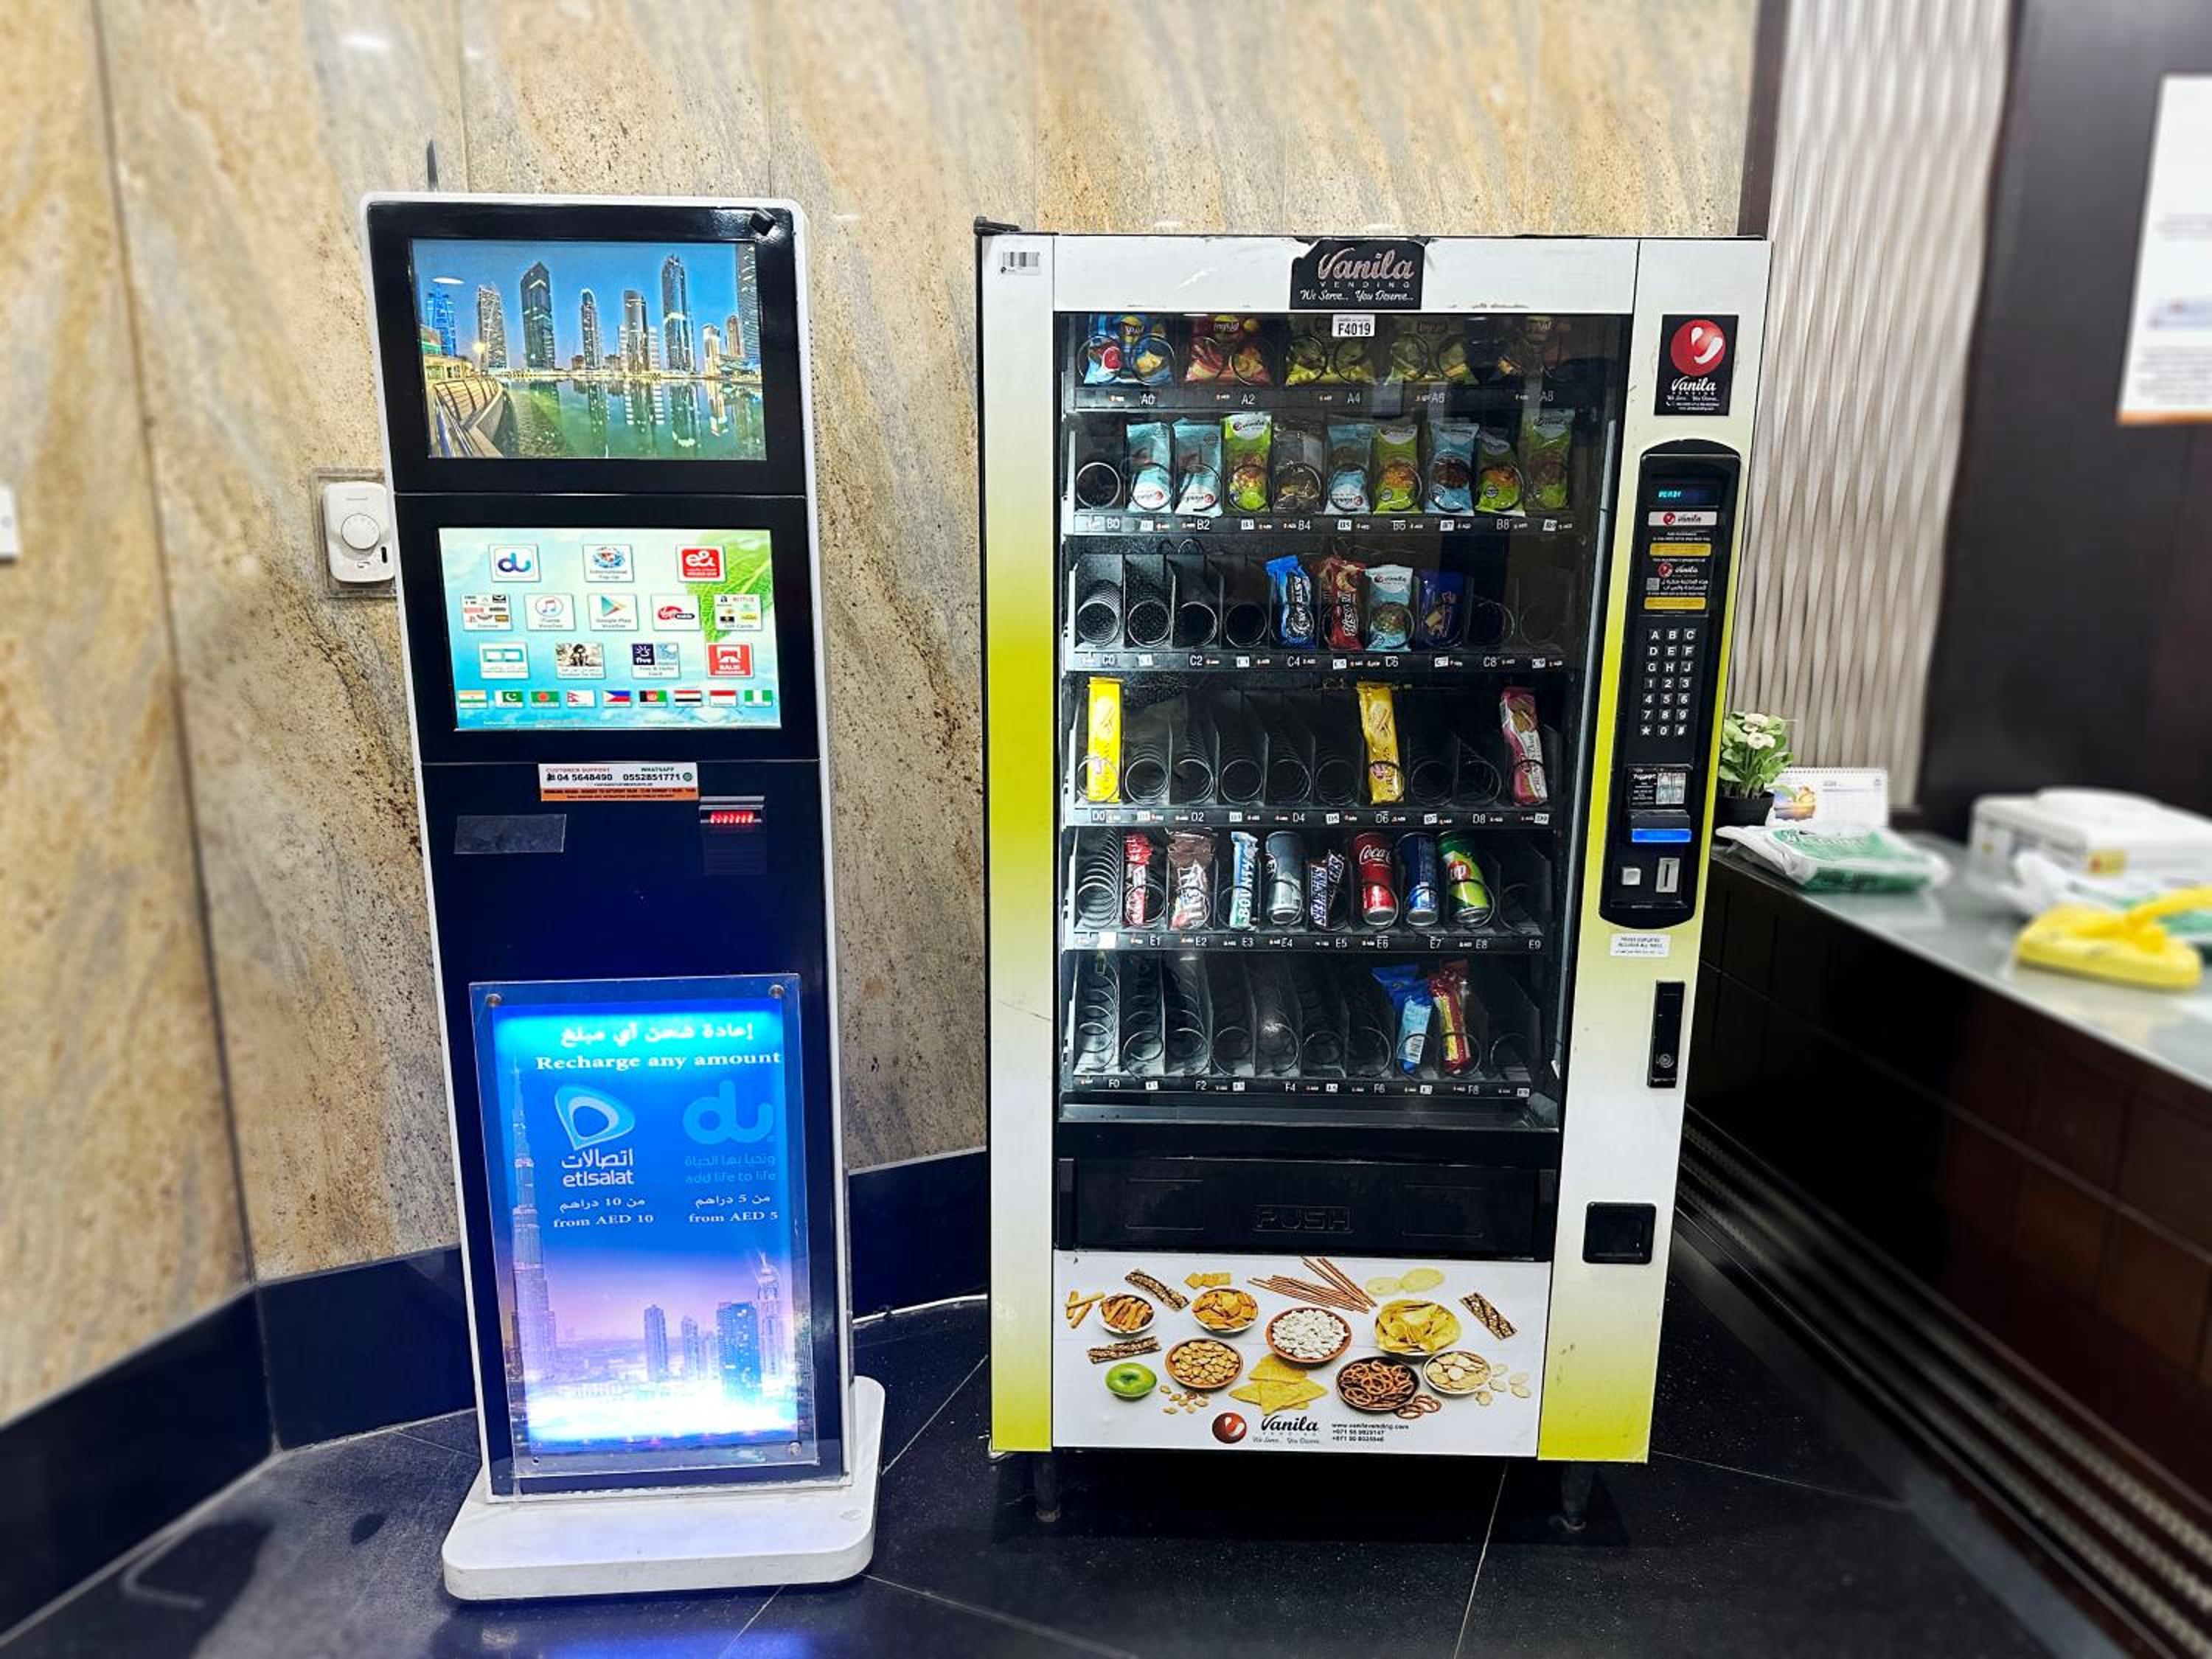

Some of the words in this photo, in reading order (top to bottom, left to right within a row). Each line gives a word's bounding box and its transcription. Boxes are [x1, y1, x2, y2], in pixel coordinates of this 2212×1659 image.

[1318, 247, 1415, 280] Vanila
[1300, 290, 1316, 301] We
[1355, 290, 1374, 302] You
[1338, 322, 1371, 335] F4019
[1671, 375, 1717, 392] Vanila
[1141, 395, 1156, 405] A0
[1241, 395, 1255, 405] A2
[1347, 393, 1360, 404] A4
[1197, 520, 1210, 531] B2
[1496, 519, 1509, 529] B8
[498, 552, 532, 572] du
[1652, 630, 1659, 640] A
[1669, 630, 1677, 639] B
[1686, 630, 1694, 639] C
[1649, 647, 1658, 655] D
[1667, 647, 1675, 655] E
[1685, 647, 1693, 655] F
[1189, 655, 1203, 666] C2
[1287, 656, 1300, 667] C4
[1483, 656, 1498, 667] C8
[1648, 663, 1656, 672] G
[1666, 664, 1674, 672] H
[1683, 663, 1691, 672] J
[1649, 679, 1652, 688] 1
[1664, 679, 1672, 688] 2
[1682, 679, 1689, 687] 3
[1645, 695, 1652, 703] 4
[1680, 695, 1688, 703] 6
[1644, 711, 1650, 720] 7
[1661, 711, 1669, 720] 8
[1679, 711, 1686, 720] 9
[1660, 727, 1667, 735] 0
[1092, 811, 1105, 821] D0
[1191, 812, 1204, 822] D2
[1292, 812, 1305, 822] D4
[1375, 813, 1389, 823] D6
[1472, 813, 1486, 824] D8
[1239, 858, 1254, 925] BOUNTY
[1150, 936, 1161, 946] E1
[1195, 936, 1207, 946] E2
[1242, 937, 1253, 947] E3
[1281, 937, 1293, 947] E4
[1335, 939, 1347, 948] E5
[1377, 939, 1388, 949] E6
[1430, 939, 1441, 949] E7
[1475, 939, 1487, 949] E8
[1528, 939, 1541, 949] E9
[536, 1055, 641, 1071] Recharge
[648, 1055, 687, 1069] any
[694, 1051, 782, 1066] amount
[1108, 1079, 1120, 1088] F0
[1195, 1080, 1207, 1091] F2
[1285, 1082, 1296, 1091] F4
[1374, 1083, 1385, 1093] F6
[683, 1079, 775, 1144] du
[561, 1148, 633, 1170] اتصالات
[563, 1169, 635, 1188] etisalat
[685, 1172, 712, 1184] add
[714, 1171, 735, 1182] life
[738, 1172, 753, 1182] to
[756, 1169, 776, 1180] life
[605, 1197, 622, 1206] 10
[626, 1198, 645, 1208] من
[695, 1194, 734, 1209] دراهم
[738, 1194, 747, 1203] 5
[751, 1194, 771, 1204] من
[560, 1199, 599, 1214] دراهم
[554, 1218, 591, 1228] from
[596, 1215, 632, 1225] AED
[638, 1214, 654, 1224] 10
[689, 1213, 725, 1222] from
[730, 1211, 765, 1222] AED
[770, 1211, 778, 1220] 5
[1256, 1211, 1350, 1230] PUSH
[1261, 1415, 1319, 1431] Vanila
